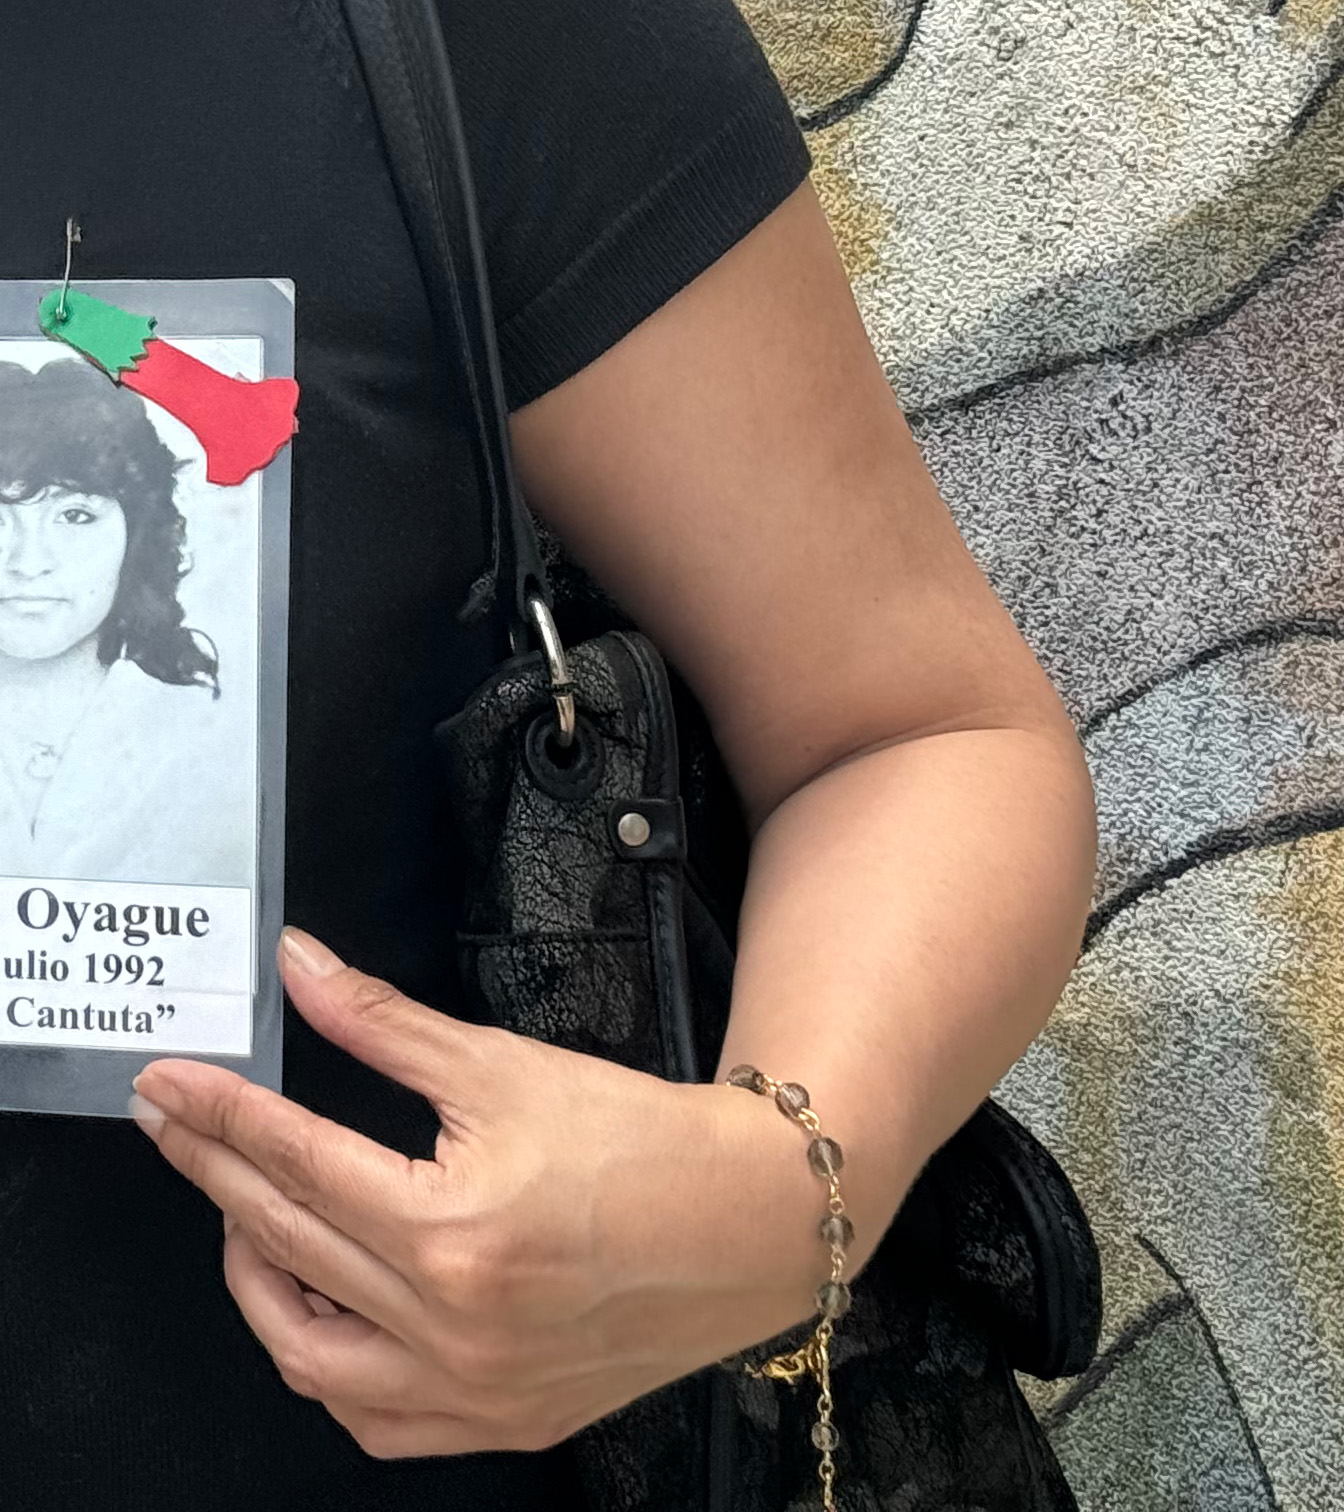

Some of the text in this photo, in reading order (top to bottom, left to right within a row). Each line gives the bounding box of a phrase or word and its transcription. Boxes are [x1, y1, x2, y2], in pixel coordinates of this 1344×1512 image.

[17, 887, 211, 947] Oyague
[85, 952, 166, 987] 1992
[6, 996, 176, 1034] Cantuta”
